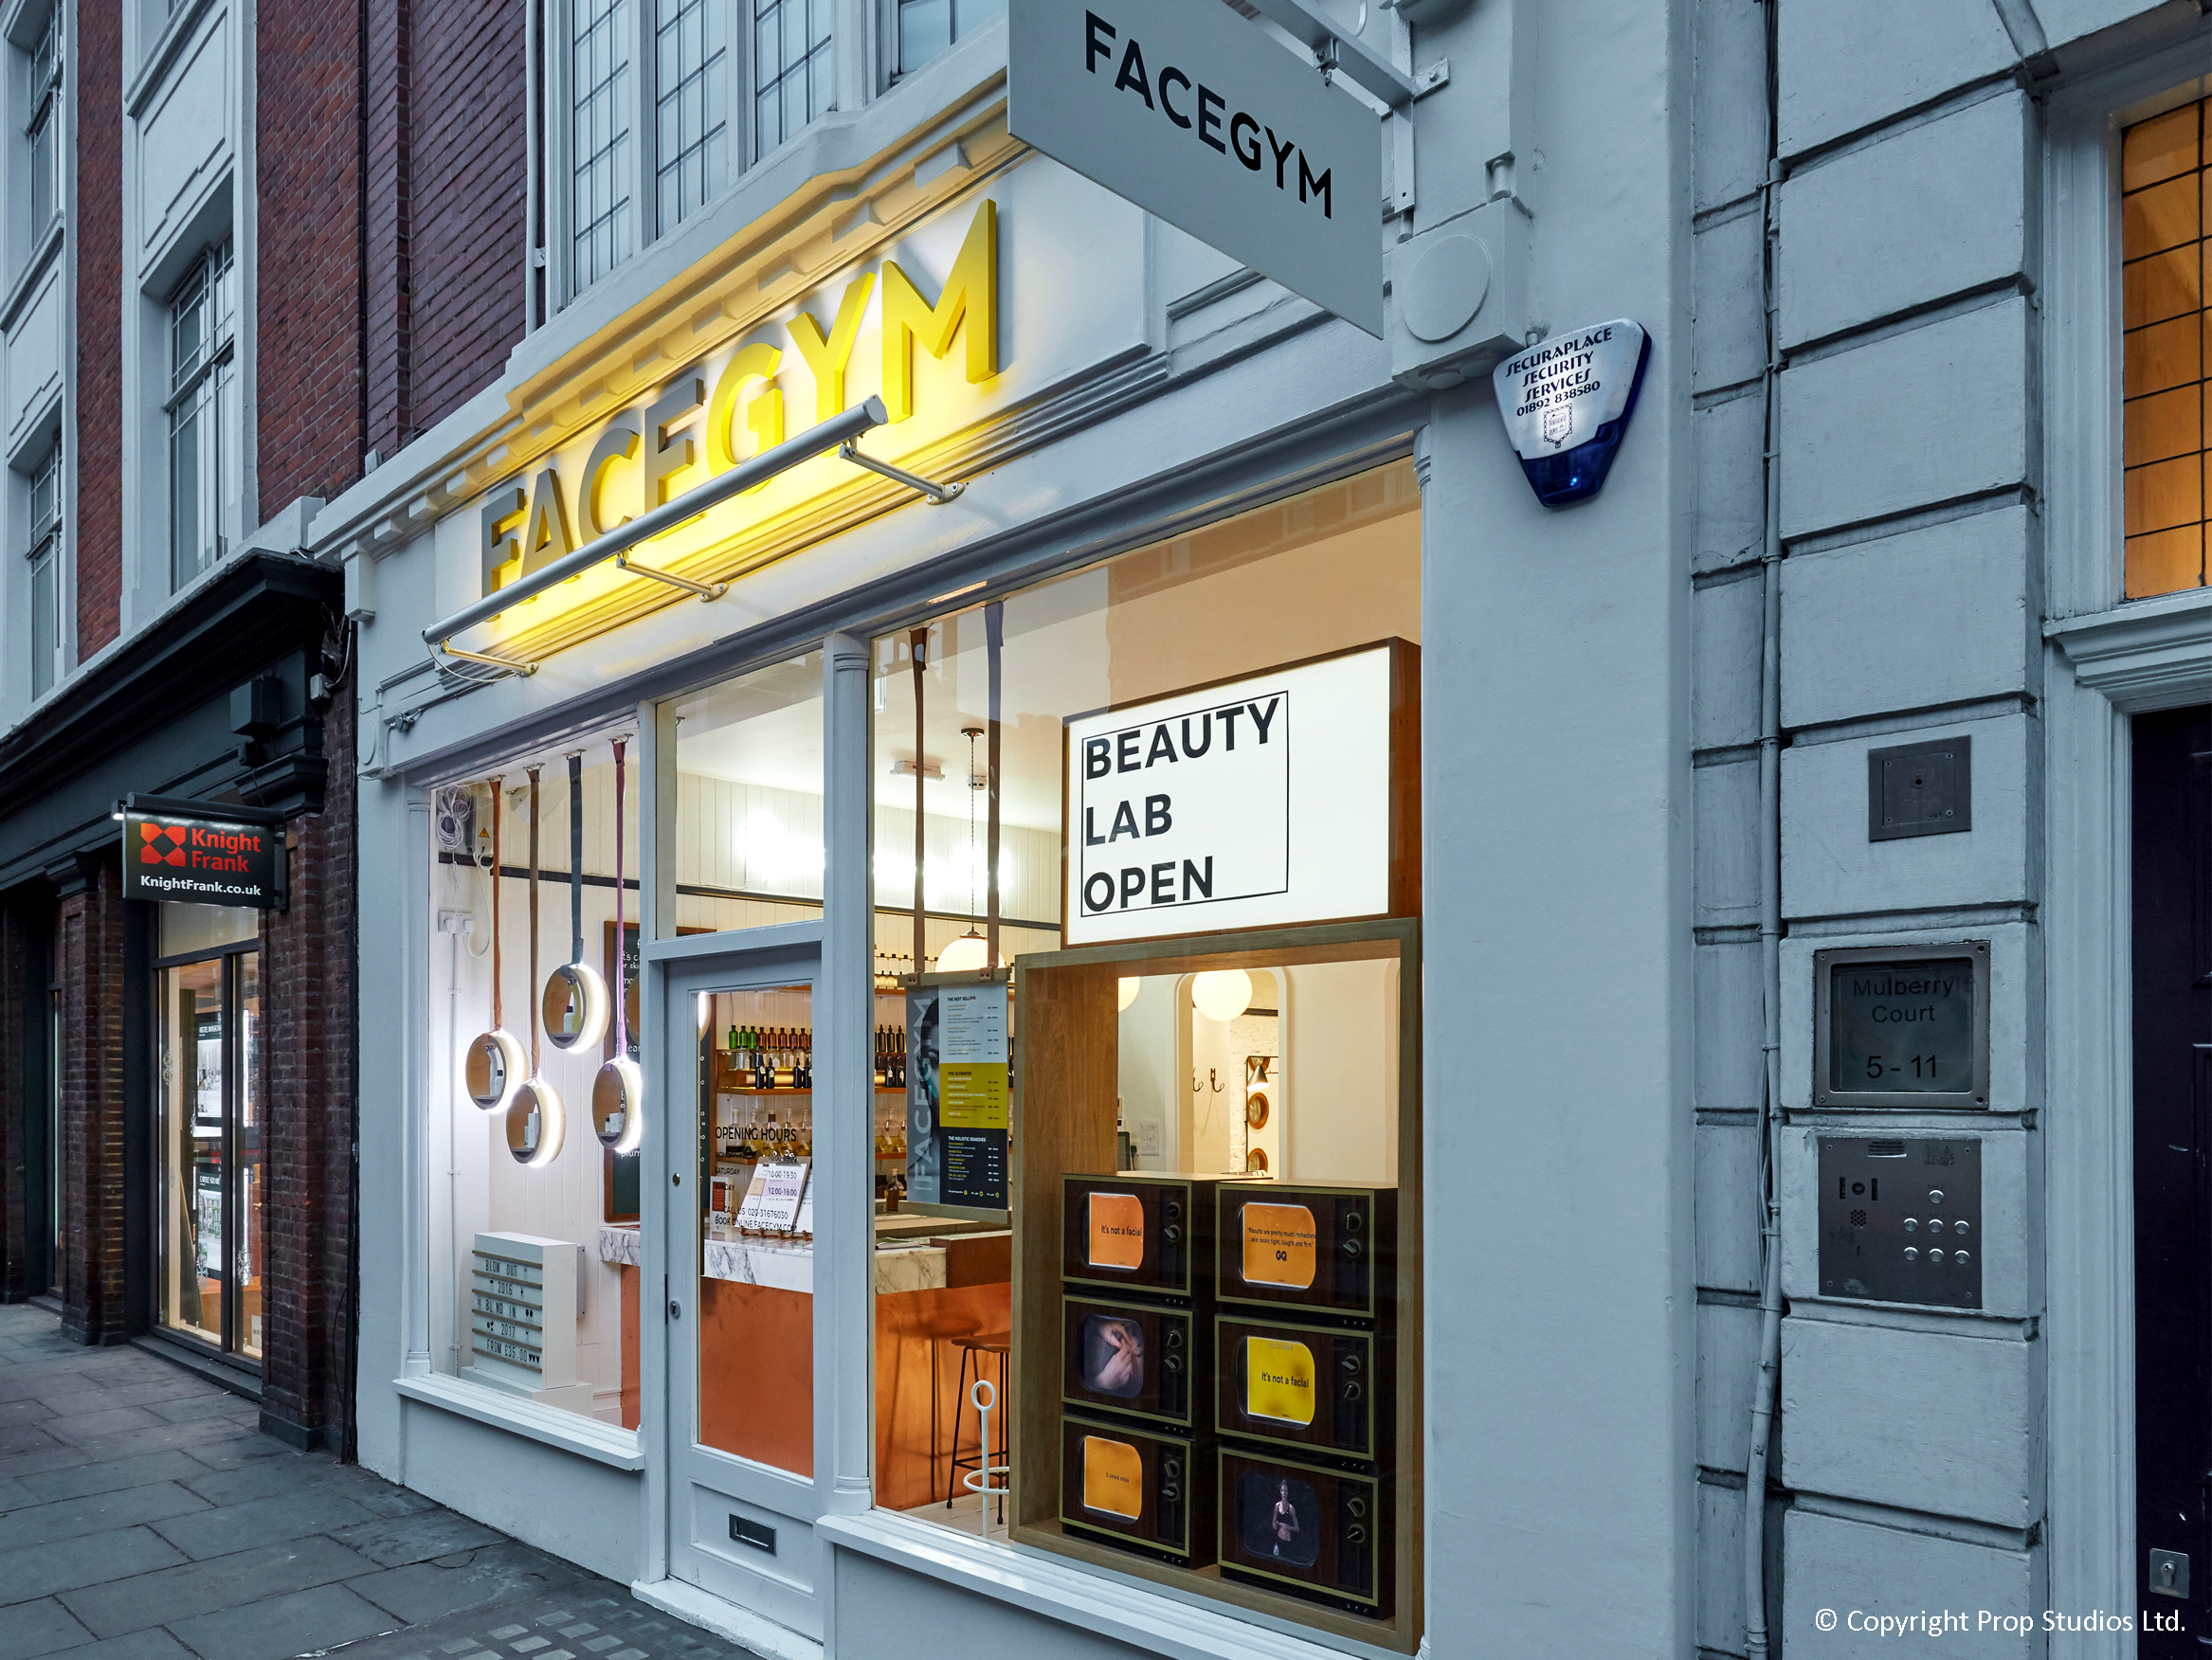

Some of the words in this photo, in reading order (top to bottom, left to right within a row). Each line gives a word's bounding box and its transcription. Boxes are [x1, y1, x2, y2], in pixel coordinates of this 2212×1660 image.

[1086, 9, 1331, 219] FACEGYM
[1505, 327, 1612, 377] SECURAPLACE
[1522, 351, 1594, 387] SECURITY
[1525, 368, 1592, 403] SERVICES
[1516, 398, 1550, 417] 01892
[1554, 381, 1601, 404] 838580
[481, 198, 997, 622] FACEGYM
[1086, 697, 1279, 780] BEAUTY
[1086, 794, 1172, 846] LAB
[191, 828, 261, 855] Knight
[191, 851, 249, 873] Frank
[140, 875, 261, 896] KnightFrank.co.uk
[1083, 856, 1213, 911] OPEN
[1854, 978, 1954, 998] Mulberry
[1872, 1004, 1935, 1022] Court
[1866, 1056, 1883, 1078] 5
[1911, 1055, 1936, 1077] 11
[915, 999, 932, 1182] FACEGYM
[715, 1127, 758, 1140] OPENING
[761, 1128, 797, 1142] HOURS
[715, 1167, 740, 1176] SATURDAY
[715, 1182, 734, 1191] SUNDAY
[723, 1206, 736, 1215] CALL
[738, 1207, 746, 1216] US
[715, 1216, 731, 1225] BOOK
[732, 1218, 753, 1228] ONLINE
[1100, 1225, 1109, 1234] It's
[1126, 1226, 1142, 1236] facial
[1276, 1250, 1287, 1261] GQ
[485, 1259, 500, 1273] BLOW
[506, 1263, 517, 1277] OUT
[498, 1281, 513, 1296] 2016
[509, 1306, 517, 1318] IN
[500, 1323, 516, 1338] 2017
[487, 1339, 502, 1354] FROM
[1261, 1371, 1271, 1381] It's
[1272, 1375, 1283, 1384] not
[1291, 1376, 1309, 1388] facial
